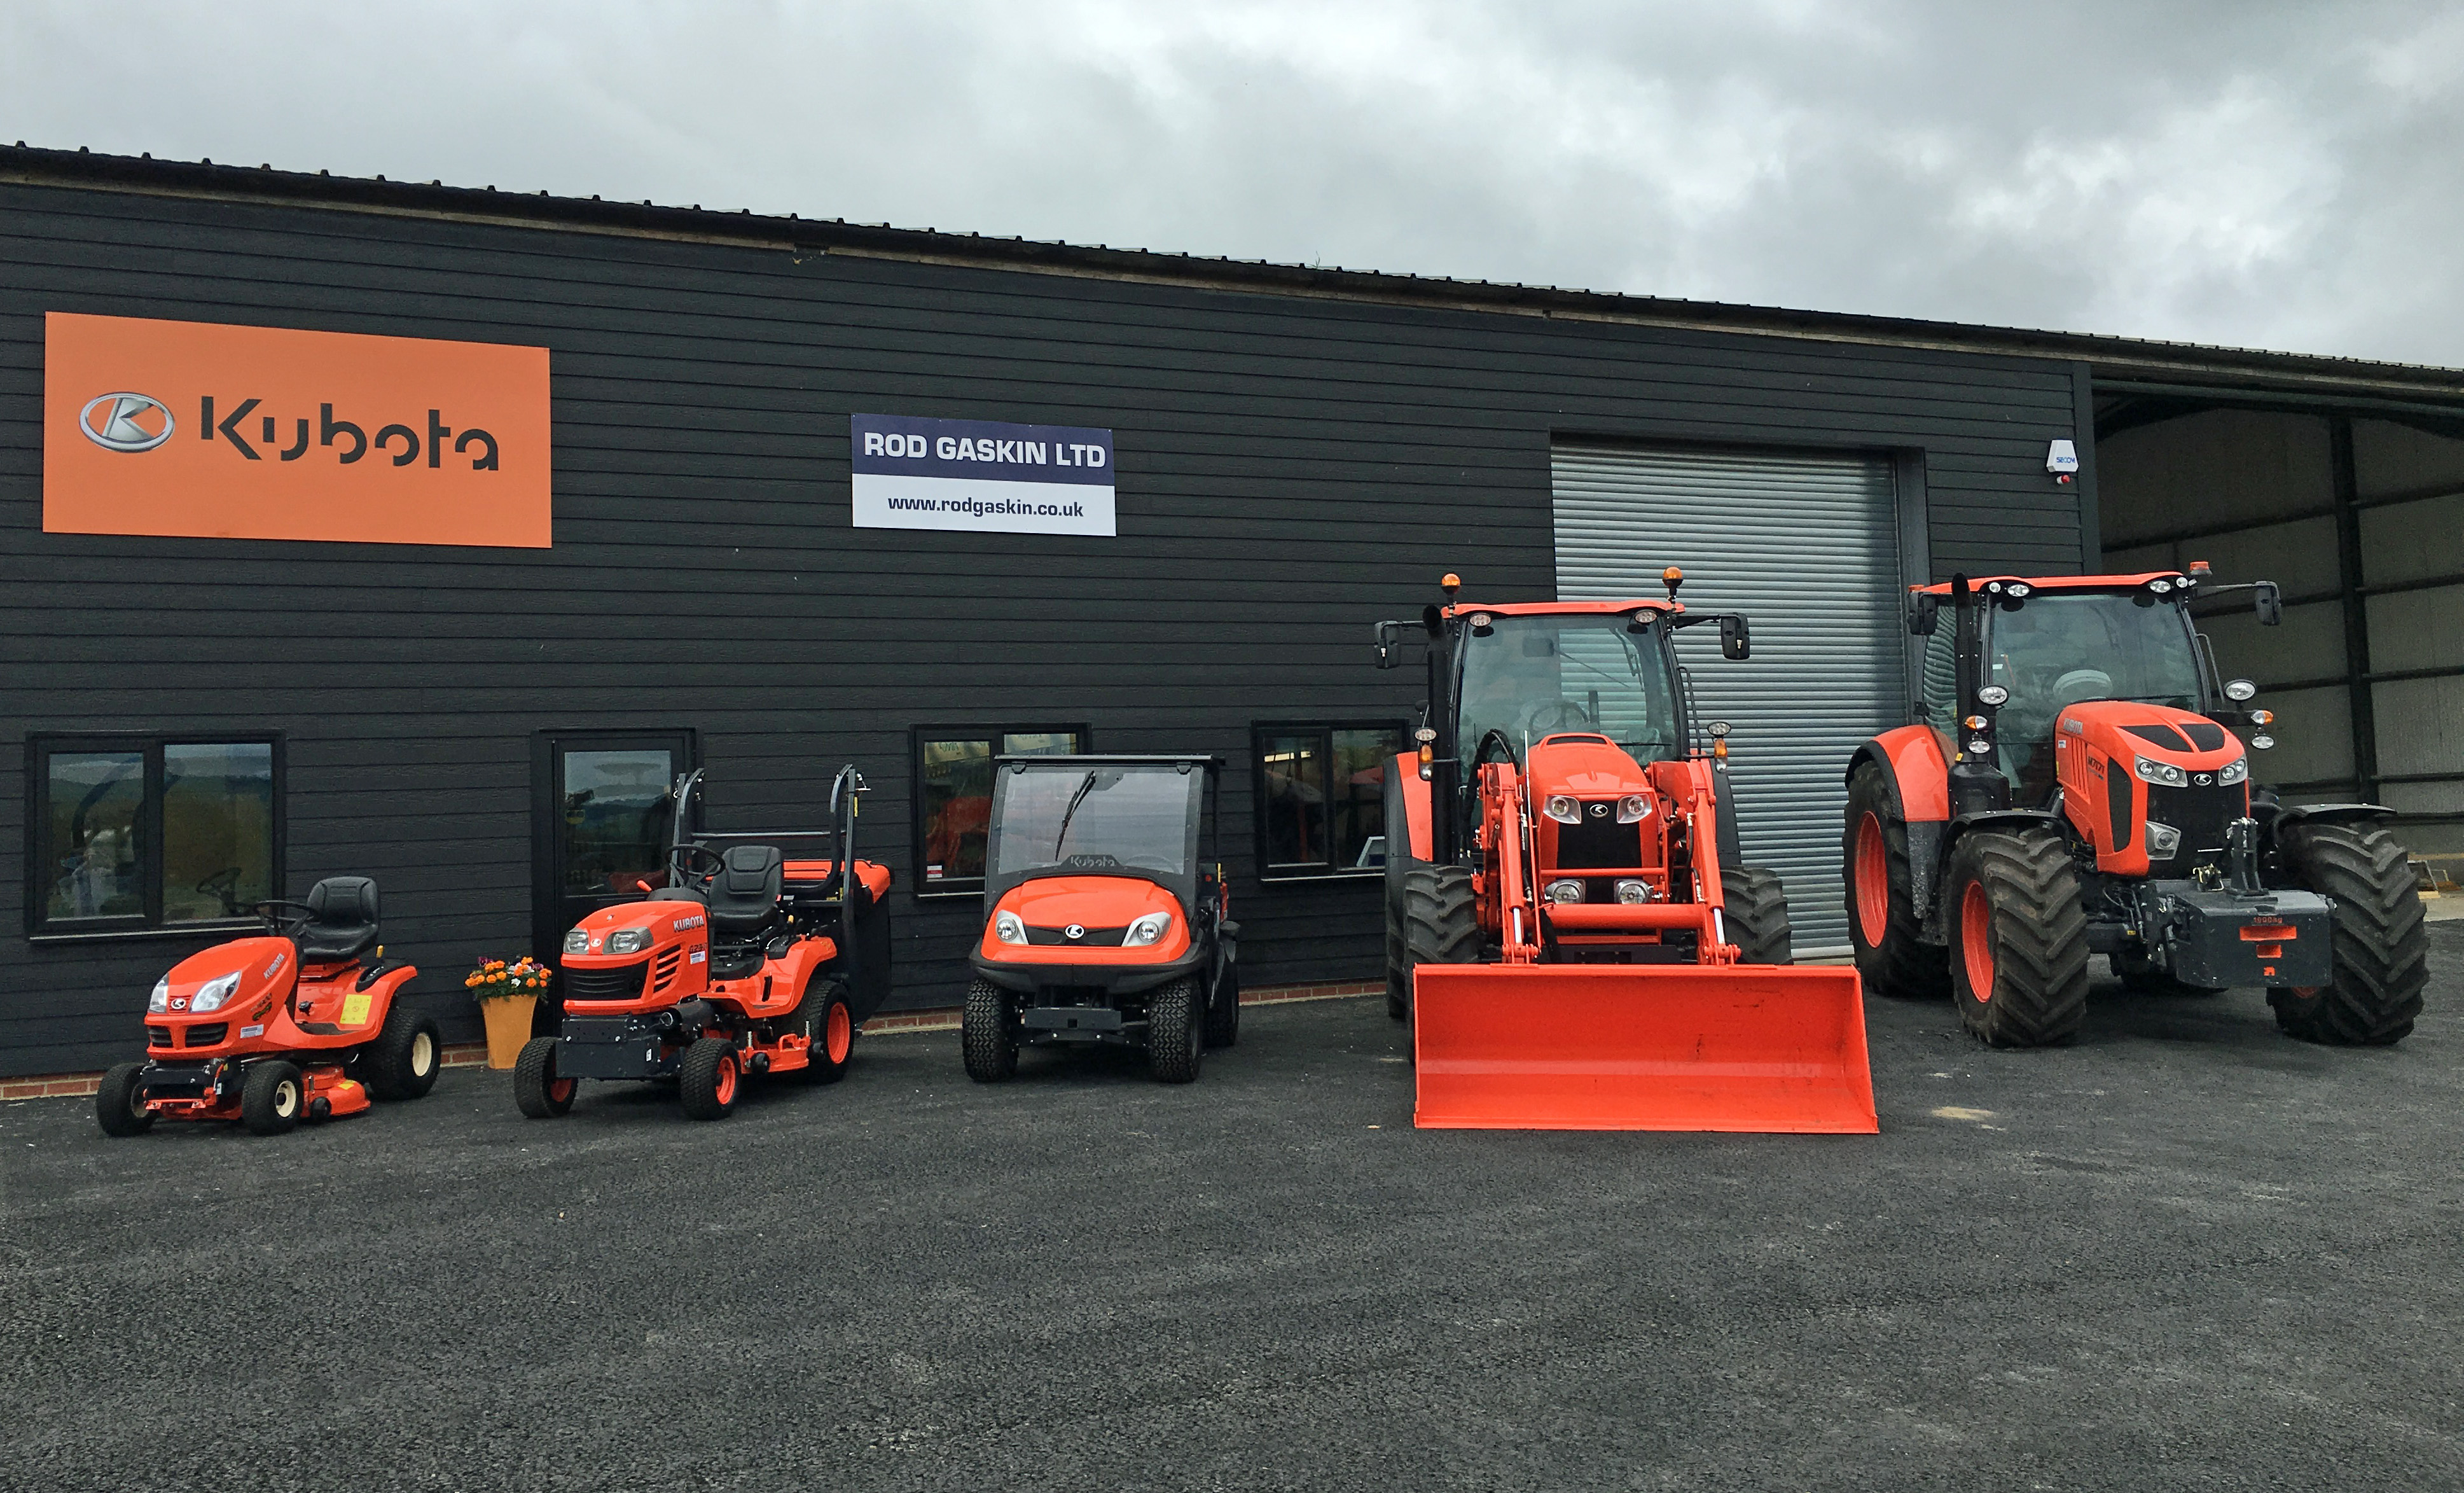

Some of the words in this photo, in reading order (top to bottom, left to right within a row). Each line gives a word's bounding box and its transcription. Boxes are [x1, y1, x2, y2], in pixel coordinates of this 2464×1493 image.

[200, 395, 499, 471] Kubota
[864, 432, 928, 459] ROD
[936, 436, 1047, 465] GASKIN
[1056, 443, 1106, 468] LTD
[888, 497, 1084, 517] www.rodgaskin.co.uk
[1070, 856, 1115, 868] Kubota
[674, 915, 705, 933] KUBOTA
[263, 952, 285, 980] KUBOTA
